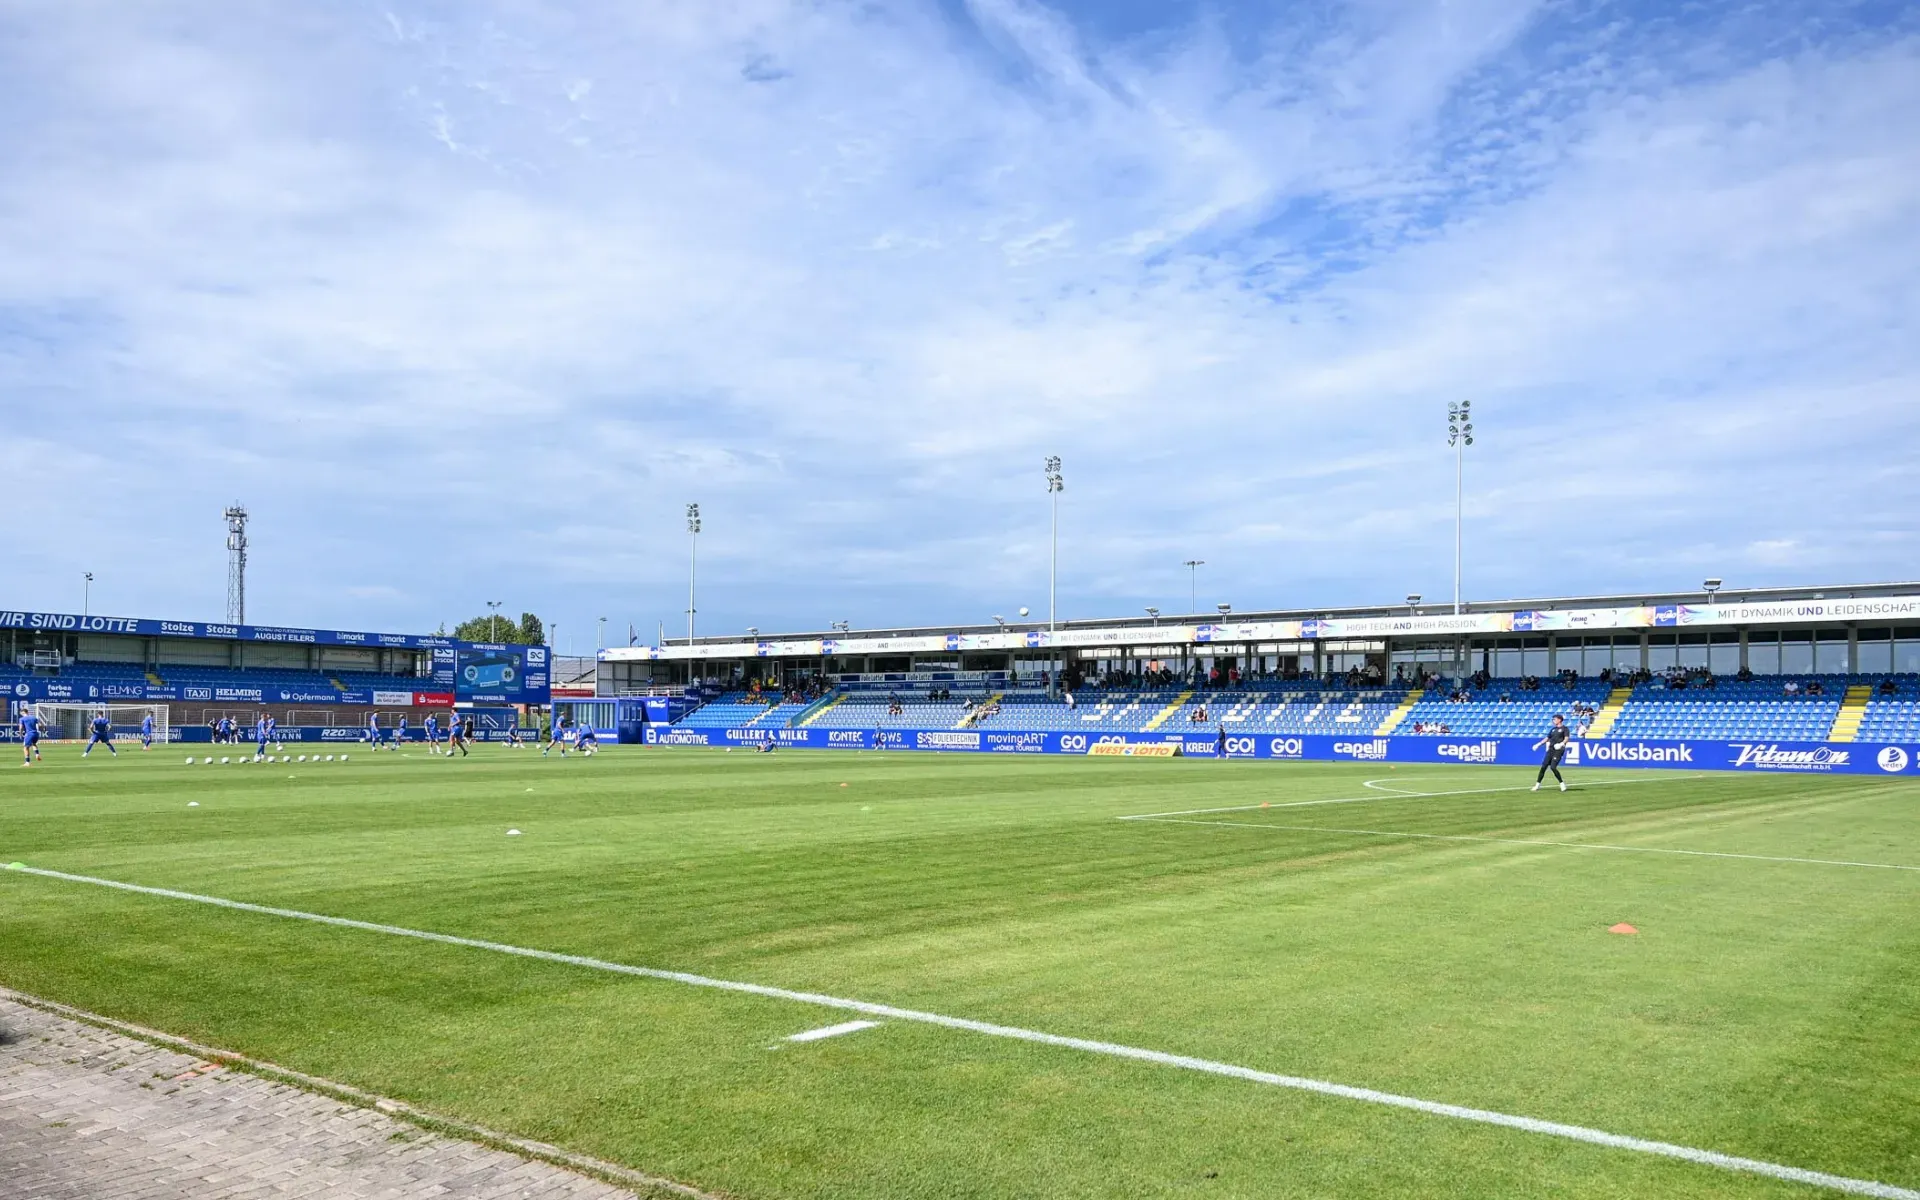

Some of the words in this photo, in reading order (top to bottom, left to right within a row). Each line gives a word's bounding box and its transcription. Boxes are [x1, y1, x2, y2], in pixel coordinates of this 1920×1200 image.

[1718, 610, 1736, 618] MIT
[1742, 608, 1794, 618] DYNAMIK
[1798, 606, 1823, 616] UND
[30, 614, 75, 628] SIND
[80, 616, 138, 632] LOTTE
[161, 622, 194, 632] Stolze
[1394, 622, 1412, 630] AND
[206, 624, 238, 634] Stolze
[187, 689, 208, 698] TAXI
[216, 688, 262, 696] HELMING
[292, 693, 335, 701] Opfermann
[659, 734, 708, 744] AUTOMOTIVE
[726, 729, 764, 740] GULLERT
[768, 730, 776, 740] &
[779, 730, 808, 740] WILKE
[829, 732, 863, 742] KONTEC
[934, 734, 978, 743] FOLIENTECHNIK
[988, 733, 1044, 746] movingART
[1060, 735, 1086, 749] GO!
[1186, 742, 1215, 753] KREUZ
[1225, 738, 1255, 753] GO!
[1271, 738, 1302, 754] GO!
[1094, 746, 1125, 754] WEST
[1133, 747, 1170, 755] LOTTO
[1334, 740, 1387, 757] capelli
[1438, 741, 1497, 759] capelli
[1584, 743, 1692, 761] Volksbank
